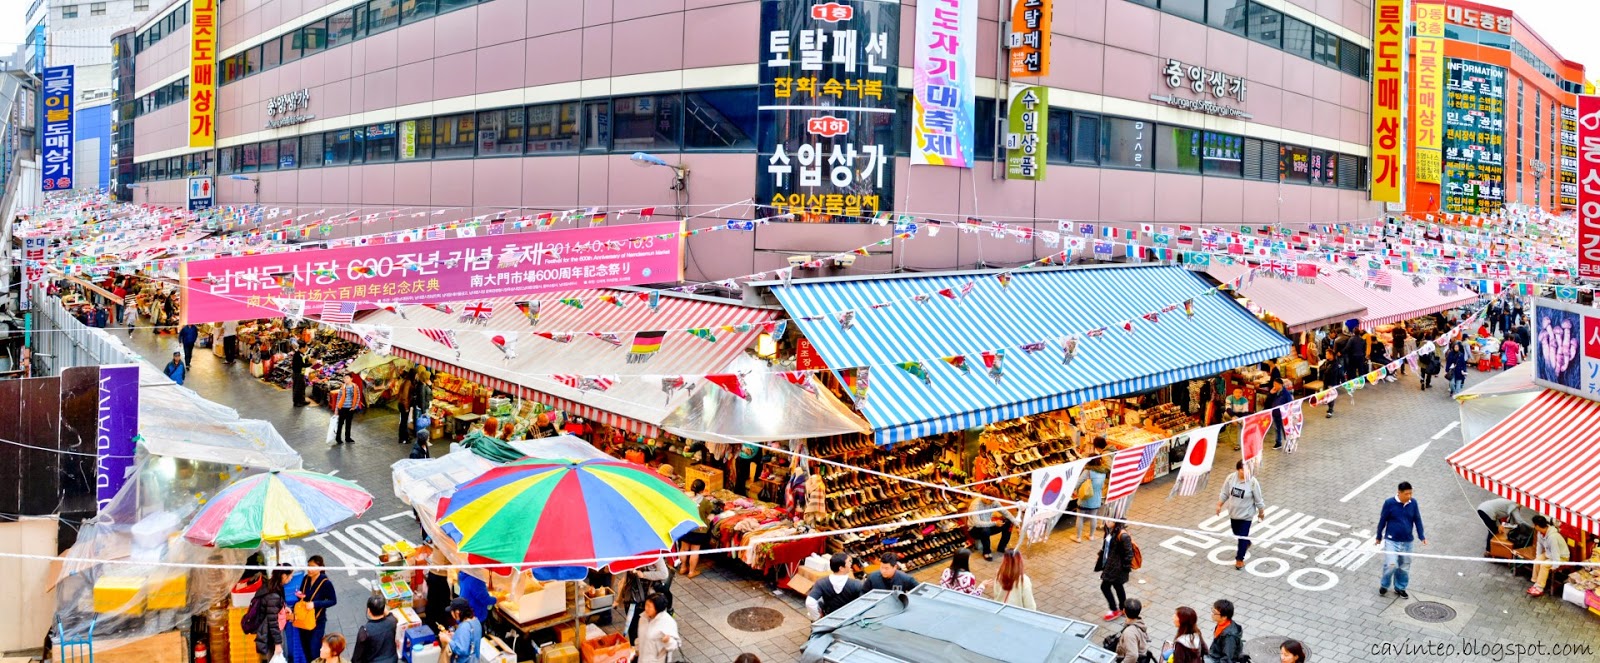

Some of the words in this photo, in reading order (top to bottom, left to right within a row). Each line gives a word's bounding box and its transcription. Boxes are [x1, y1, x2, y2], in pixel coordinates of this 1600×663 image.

[818, 8, 847, 18] 1층
[1418, 7, 1443, 20] D동
[1447, 5, 1512, 33] 대도종합
[1011, 34, 1019, 46] 1F
[1418, 20, 1441, 34] 3층
[768, 29, 888, 74] 토탈패션
[923, 0, 960, 156] 도자기대축제
[1163, 58, 1247, 102] 중앙상가
[1447, 62, 1503, 79] INFORMATION
[1375, 5, 1400, 188] 릇도매상가
[1419, 40, 1438, 146] 그릇도매상가
[813, 120, 844, 132] 지하
[1021, 91, 1037, 176] 수입상품
[1008, 135, 1016, 147] B1
[768, 143, 887, 188] 수입상가
[44, 177, 71, 190] 3층
[771, 192, 880, 217] 수입상품일체
[293, 260, 340, 286] 시장
[470, 262, 631, 288] 南大門市場600周年記念祭り
